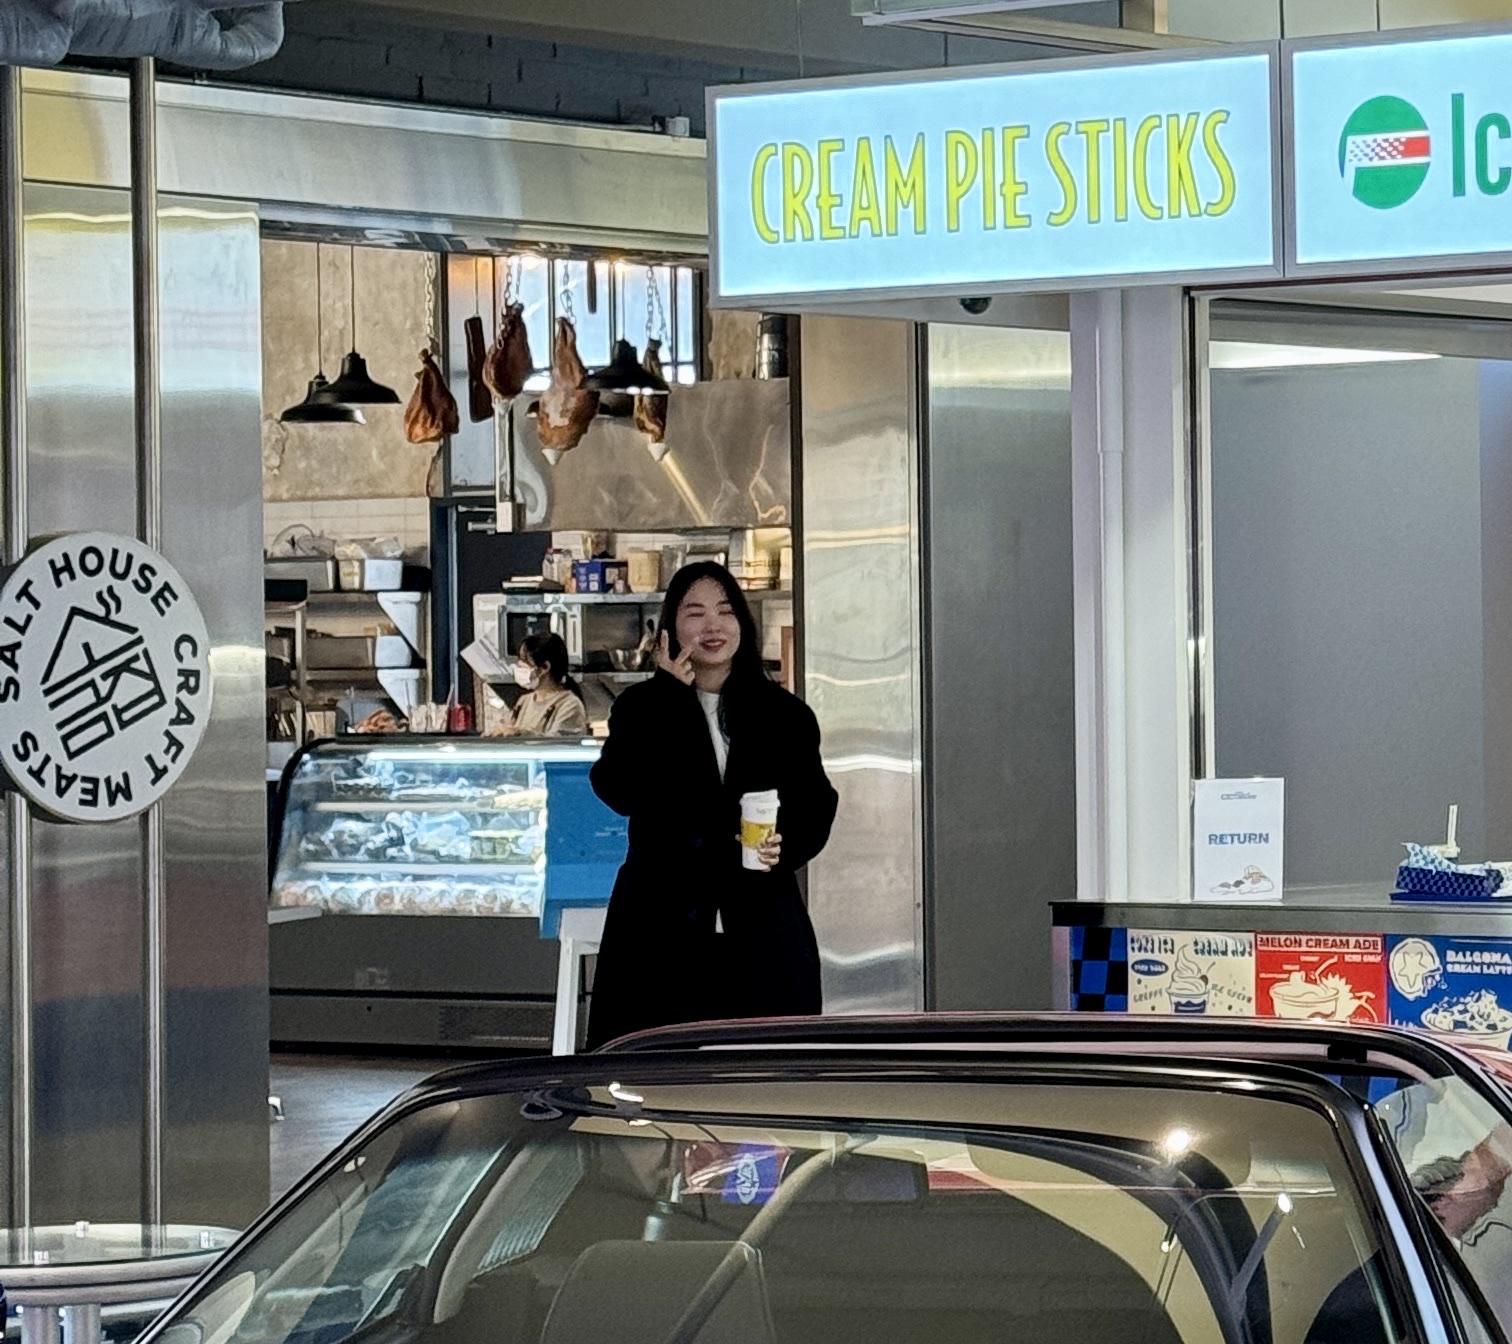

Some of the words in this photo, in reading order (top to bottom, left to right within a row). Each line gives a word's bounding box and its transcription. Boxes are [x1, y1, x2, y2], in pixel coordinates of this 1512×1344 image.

[751, 132, 928, 244] CREAM
[945, 124, 1032, 233] PIE
[1045, 109, 1237, 227] STICKS
[48, 545, 179, 617] HOUSE
[0, 578, 42, 703] SALT
[141, 633, 201, 786] CRAFT
[12, 729, 133, 808] MEATS
[1207, 832, 1270, 846] RETURN
[1258, 937, 1302, 949] MELON
[1305, 938, 1351, 950] CREAM
[1353, 939, 1380, 951] ADE
[1445, 964, 1481, 974] CREAM
